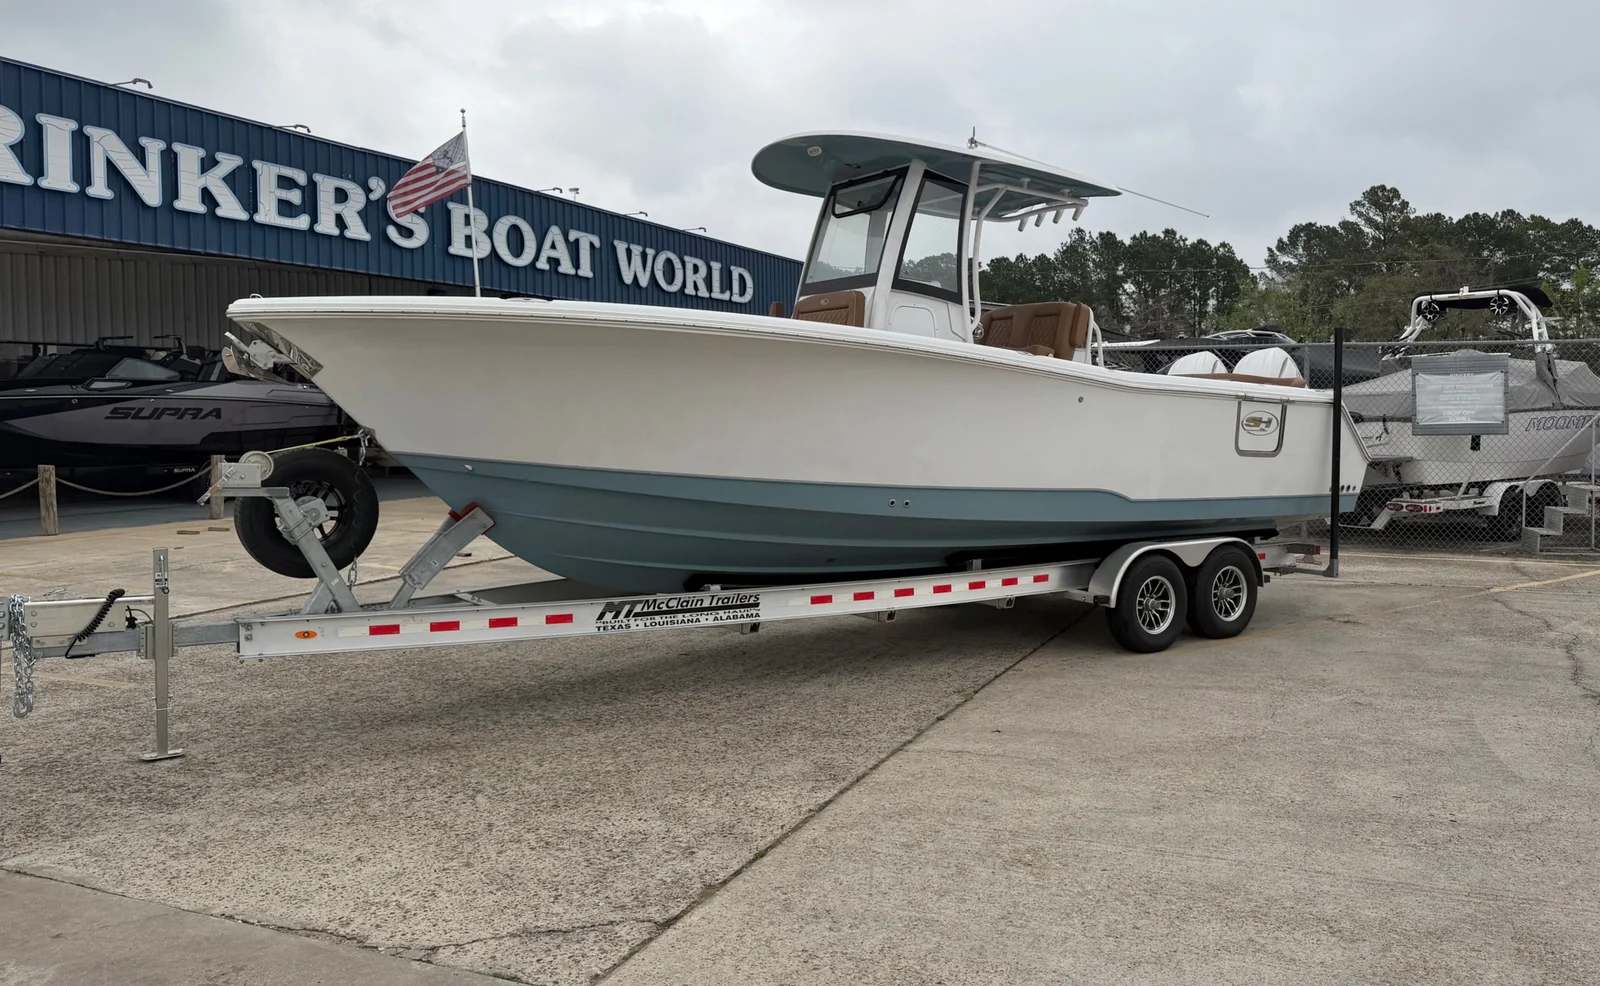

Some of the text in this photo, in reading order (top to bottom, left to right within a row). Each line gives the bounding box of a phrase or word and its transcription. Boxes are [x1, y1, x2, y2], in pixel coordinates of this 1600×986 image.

[447, 201, 600, 279] BOAT
[613, 239, 754, 303] WORLD
[104, 407, 222, 420] SUPRA
[1525, 414, 1600, 432] MOOMB
[640, 593, 760, 611] McClain Trailers
[595, 612, 761, 632] TEXAS LOUISIANA ALABAMA
